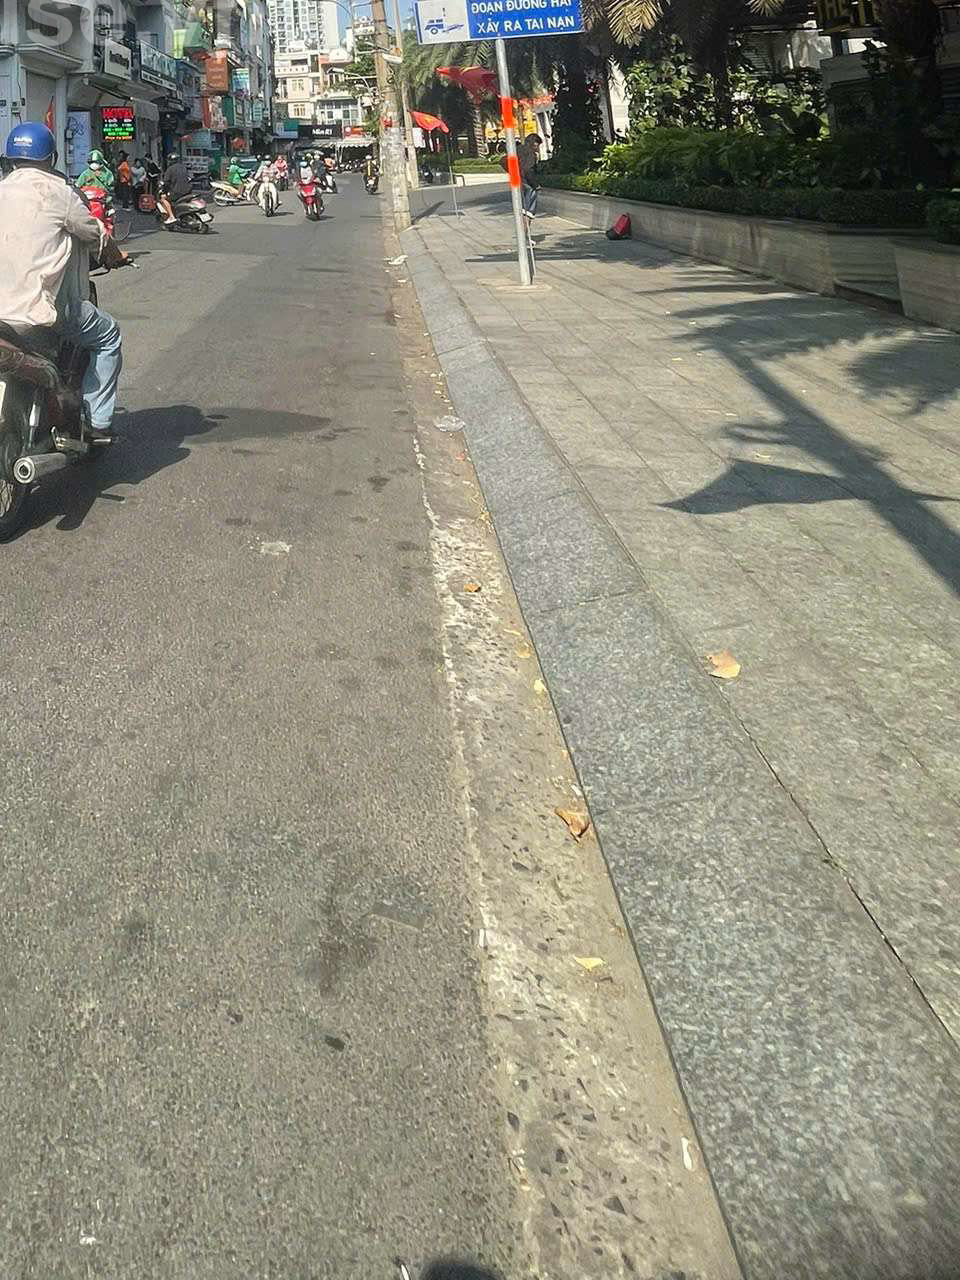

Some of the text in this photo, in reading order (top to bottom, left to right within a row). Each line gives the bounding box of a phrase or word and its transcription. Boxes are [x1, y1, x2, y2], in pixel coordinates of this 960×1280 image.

[471, 0, 503, 15] ĐOẠN
[477, 16, 575, 33] XẢY RA TAI NẠN
